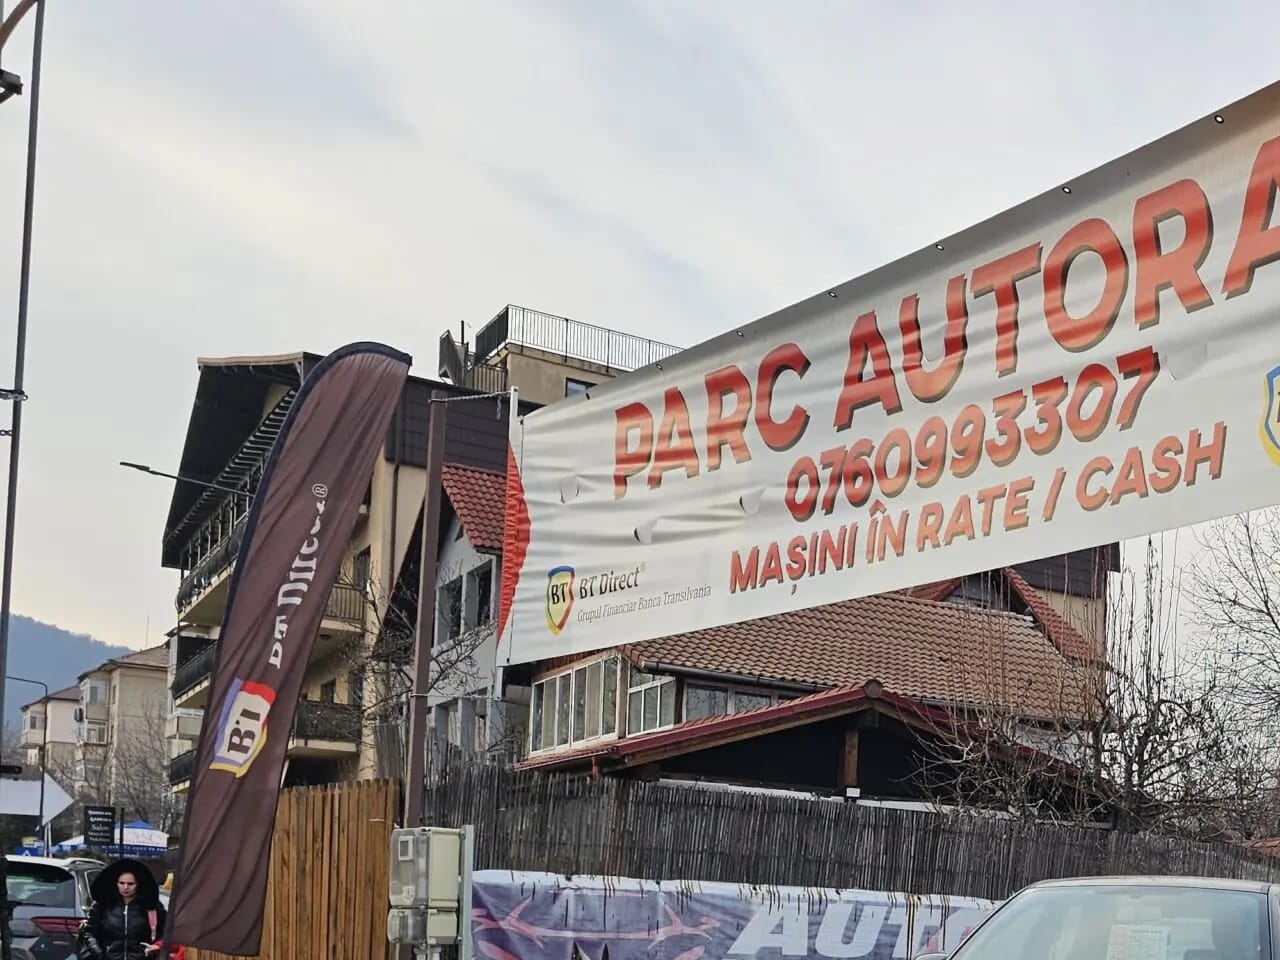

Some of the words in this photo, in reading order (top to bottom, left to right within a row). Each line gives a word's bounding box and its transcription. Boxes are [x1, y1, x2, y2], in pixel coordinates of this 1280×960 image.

[614, 343, 811, 499] PARC
[785, 346, 1160, 521] 0760993307
[728, 521, 858, 596] MAȘINI
[866, 499, 905, 564] ÎN
[916, 476, 1035, 552] RATE
[1075, 421, 1227, 511] CASH
[551, 582, 569, 605] BT
[577, 604, 602, 624] Grupul
[602, 598, 637, 618] Financiar
[638, 595, 661, 611] Banca
[663, 583, 712, 606] Transilvania
[579, 576, 598, 600] BT
